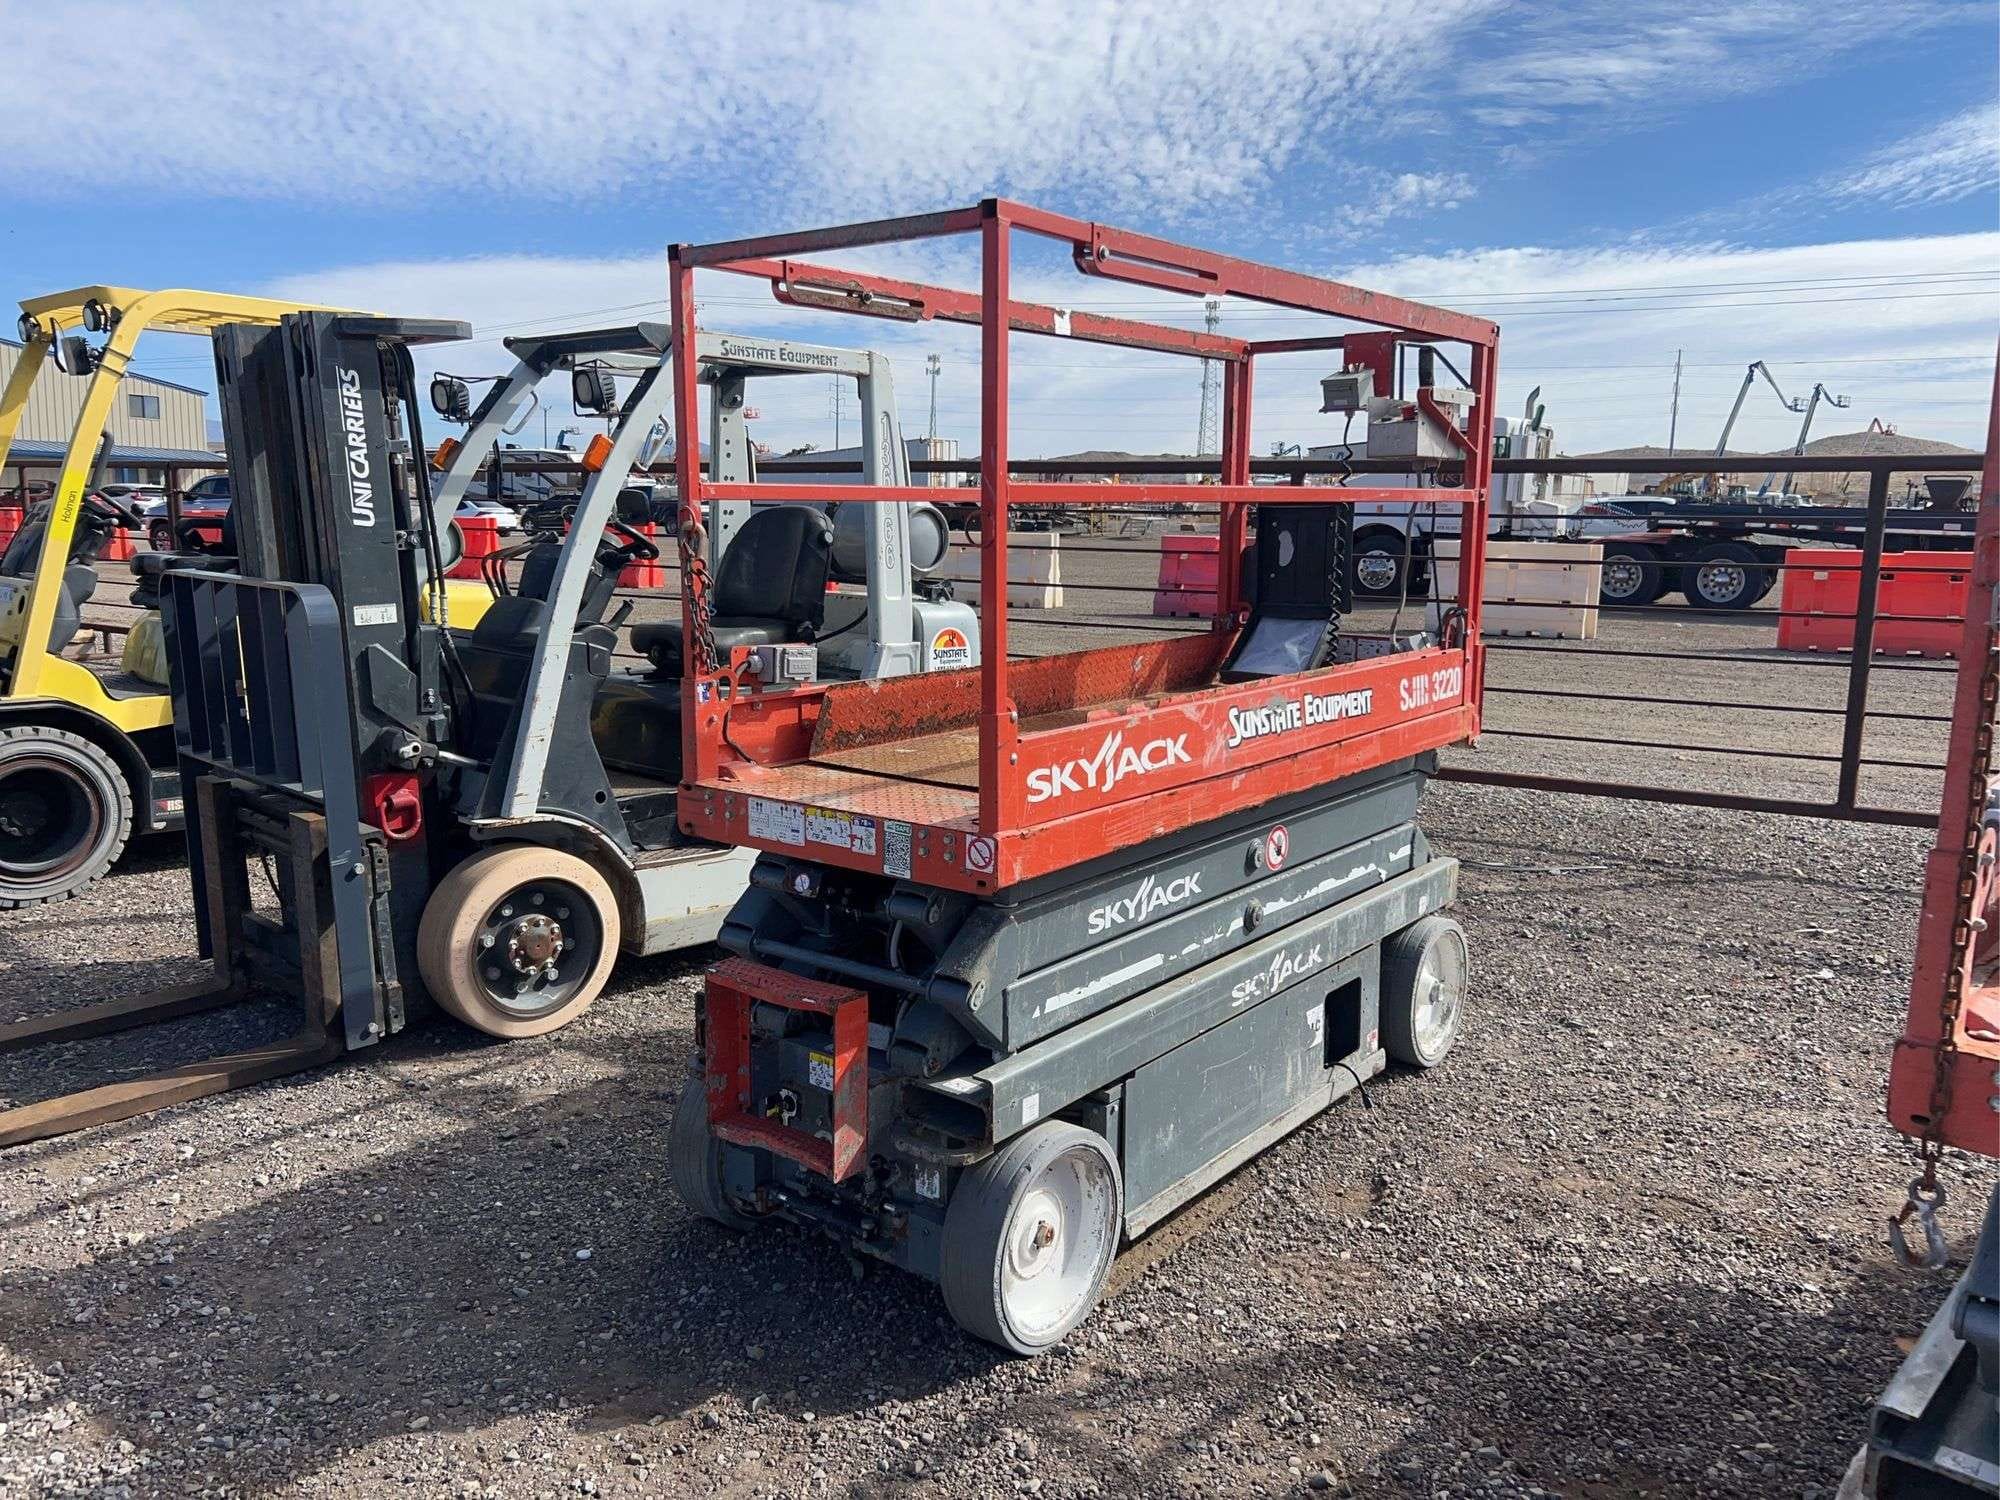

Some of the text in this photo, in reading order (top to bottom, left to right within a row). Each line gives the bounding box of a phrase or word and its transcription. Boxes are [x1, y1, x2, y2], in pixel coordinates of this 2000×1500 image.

[720, 340, 839, 367] SUNSTATE EQUIPMENT
[336, 366, 376, 528] UNICARRIERS
[61, 490, 78, 523] Holman
[933, 648, 968, 660] SUNSTATE
[1432, 666, 1461, 702] 3220
[1227, 689, 1373, 749] SUNSTATE EQUIPMENT
[1026, 730, 1192, 803] SKYJACK
[1087, 872, 1202, 935] SKYJACK
